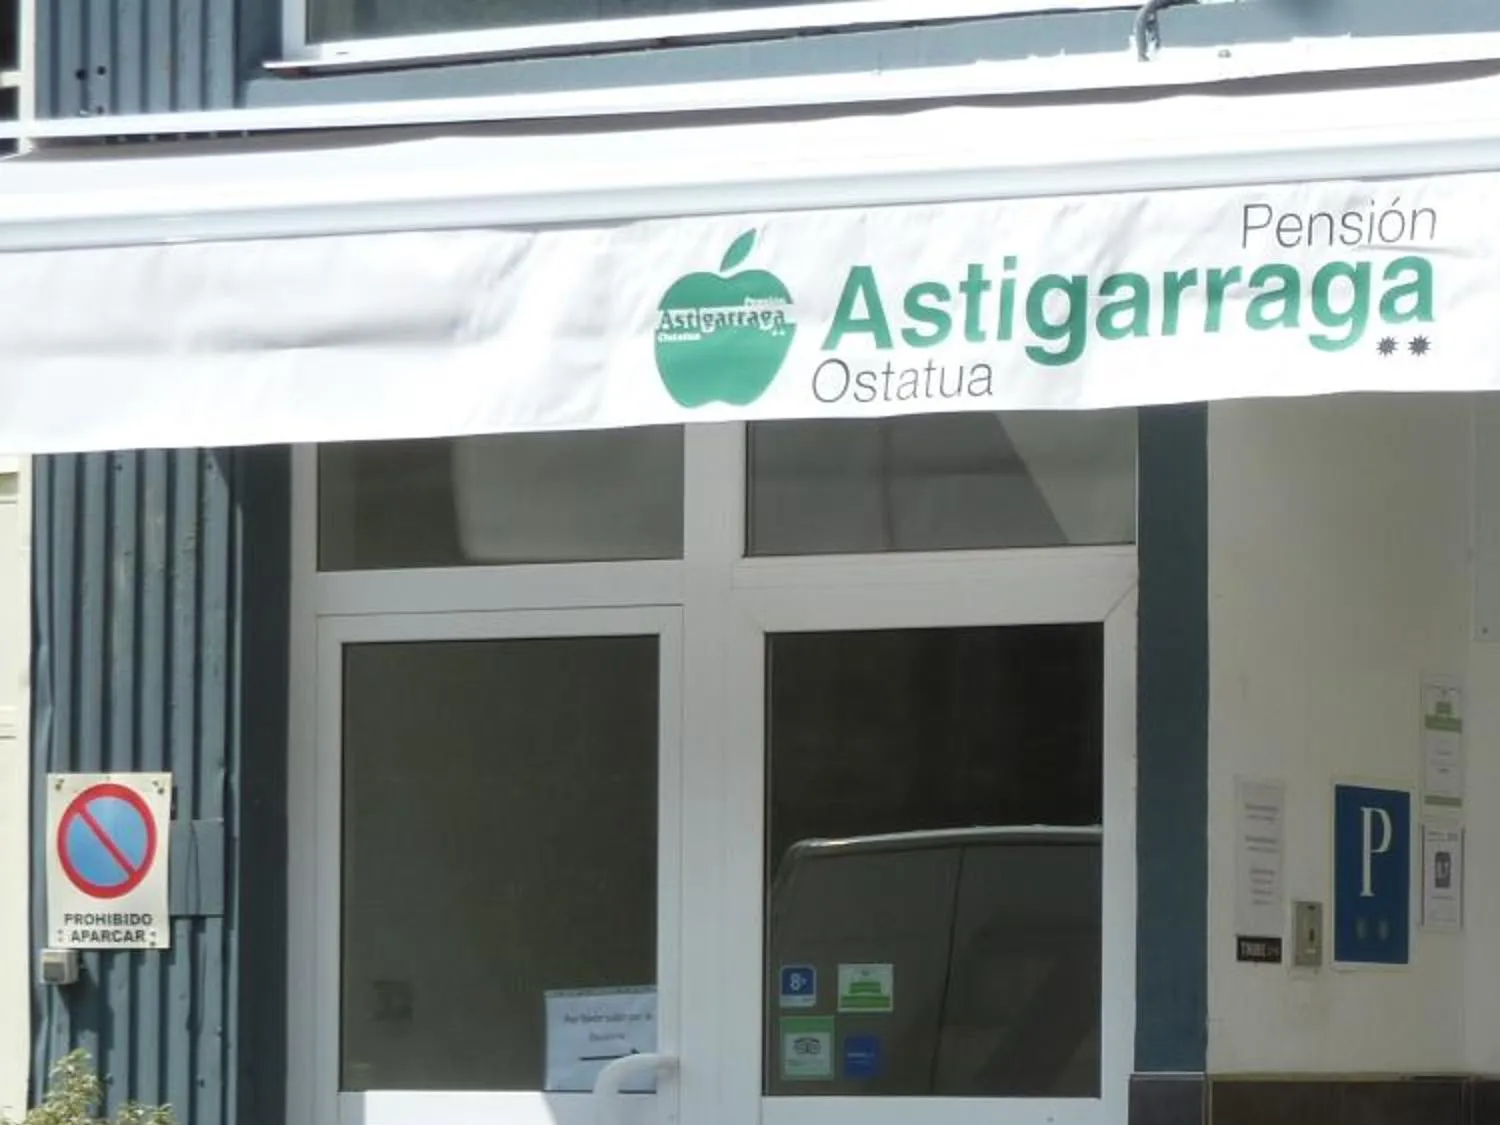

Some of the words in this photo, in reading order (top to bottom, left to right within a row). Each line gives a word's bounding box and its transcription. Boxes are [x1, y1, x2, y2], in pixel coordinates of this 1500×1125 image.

[1242, 197, 1437, 249] Pensión
[658, 307, 786, 332] Astigarraga
[820, 254, 1436, 367] Astigarraga
[811, 357, 994, 403] Ostatua
[1360, 806, 1393, 897] P
[64, 912, 153, 926] PROHIBIDO
[71, 929, 146, 943] APARCAR
